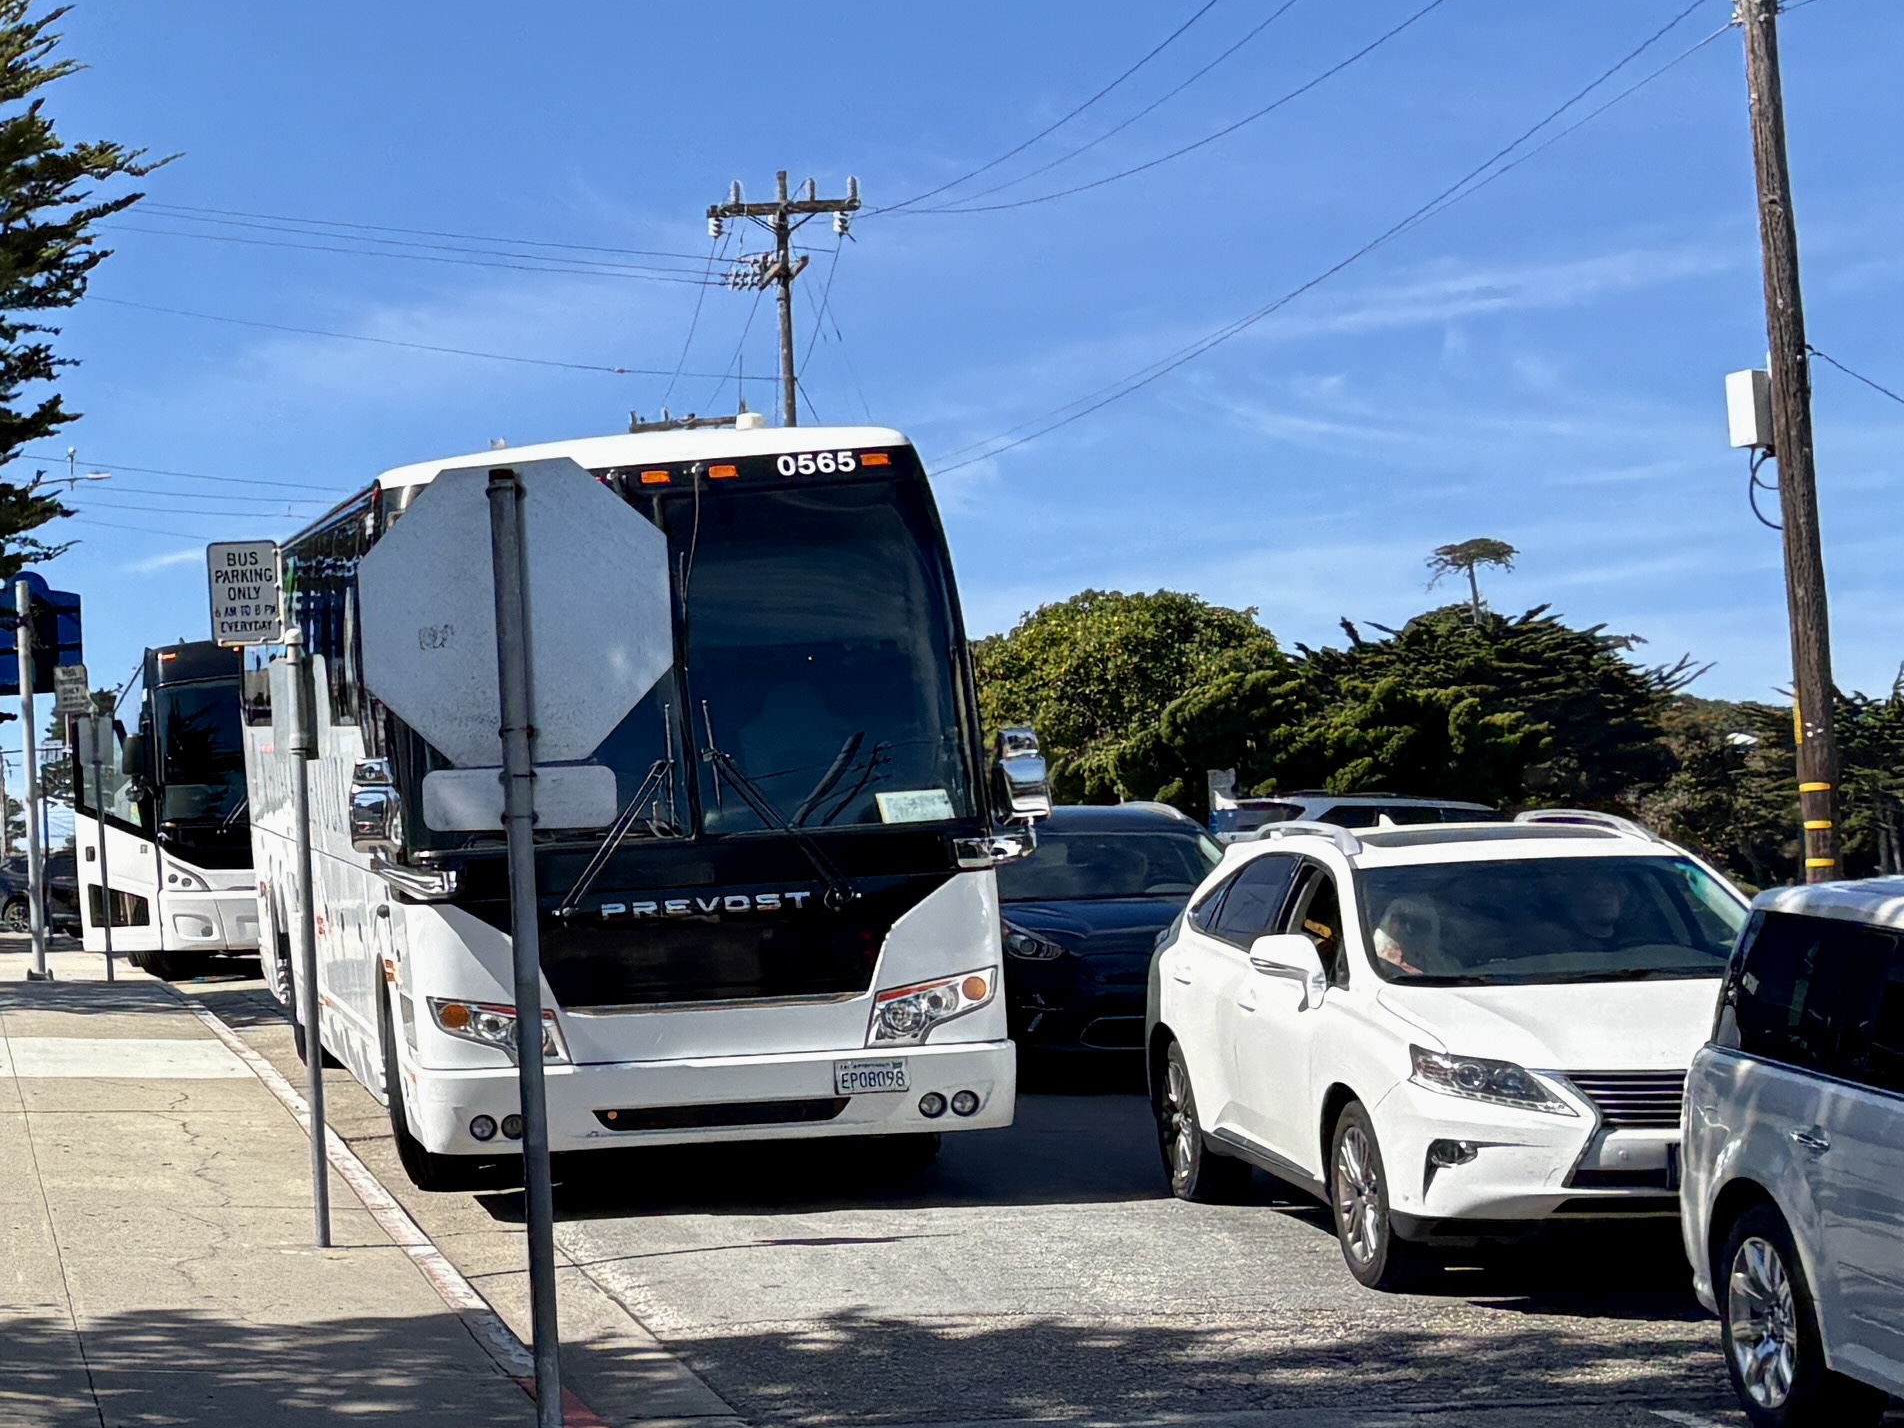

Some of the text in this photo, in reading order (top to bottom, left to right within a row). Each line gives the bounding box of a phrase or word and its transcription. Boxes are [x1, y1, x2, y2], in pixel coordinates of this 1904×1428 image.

[777, 451, 856, 477] 0565
[227, 552, 258, 566] BUS
[215, 568, 273, 583] PARKING
[228, 586, 261, 601] ONLY
[241, 605, 251, 616] TO
[220, 620, 272, 633] EVERYDAY
[601, 891, 811, 919] PREVOST
